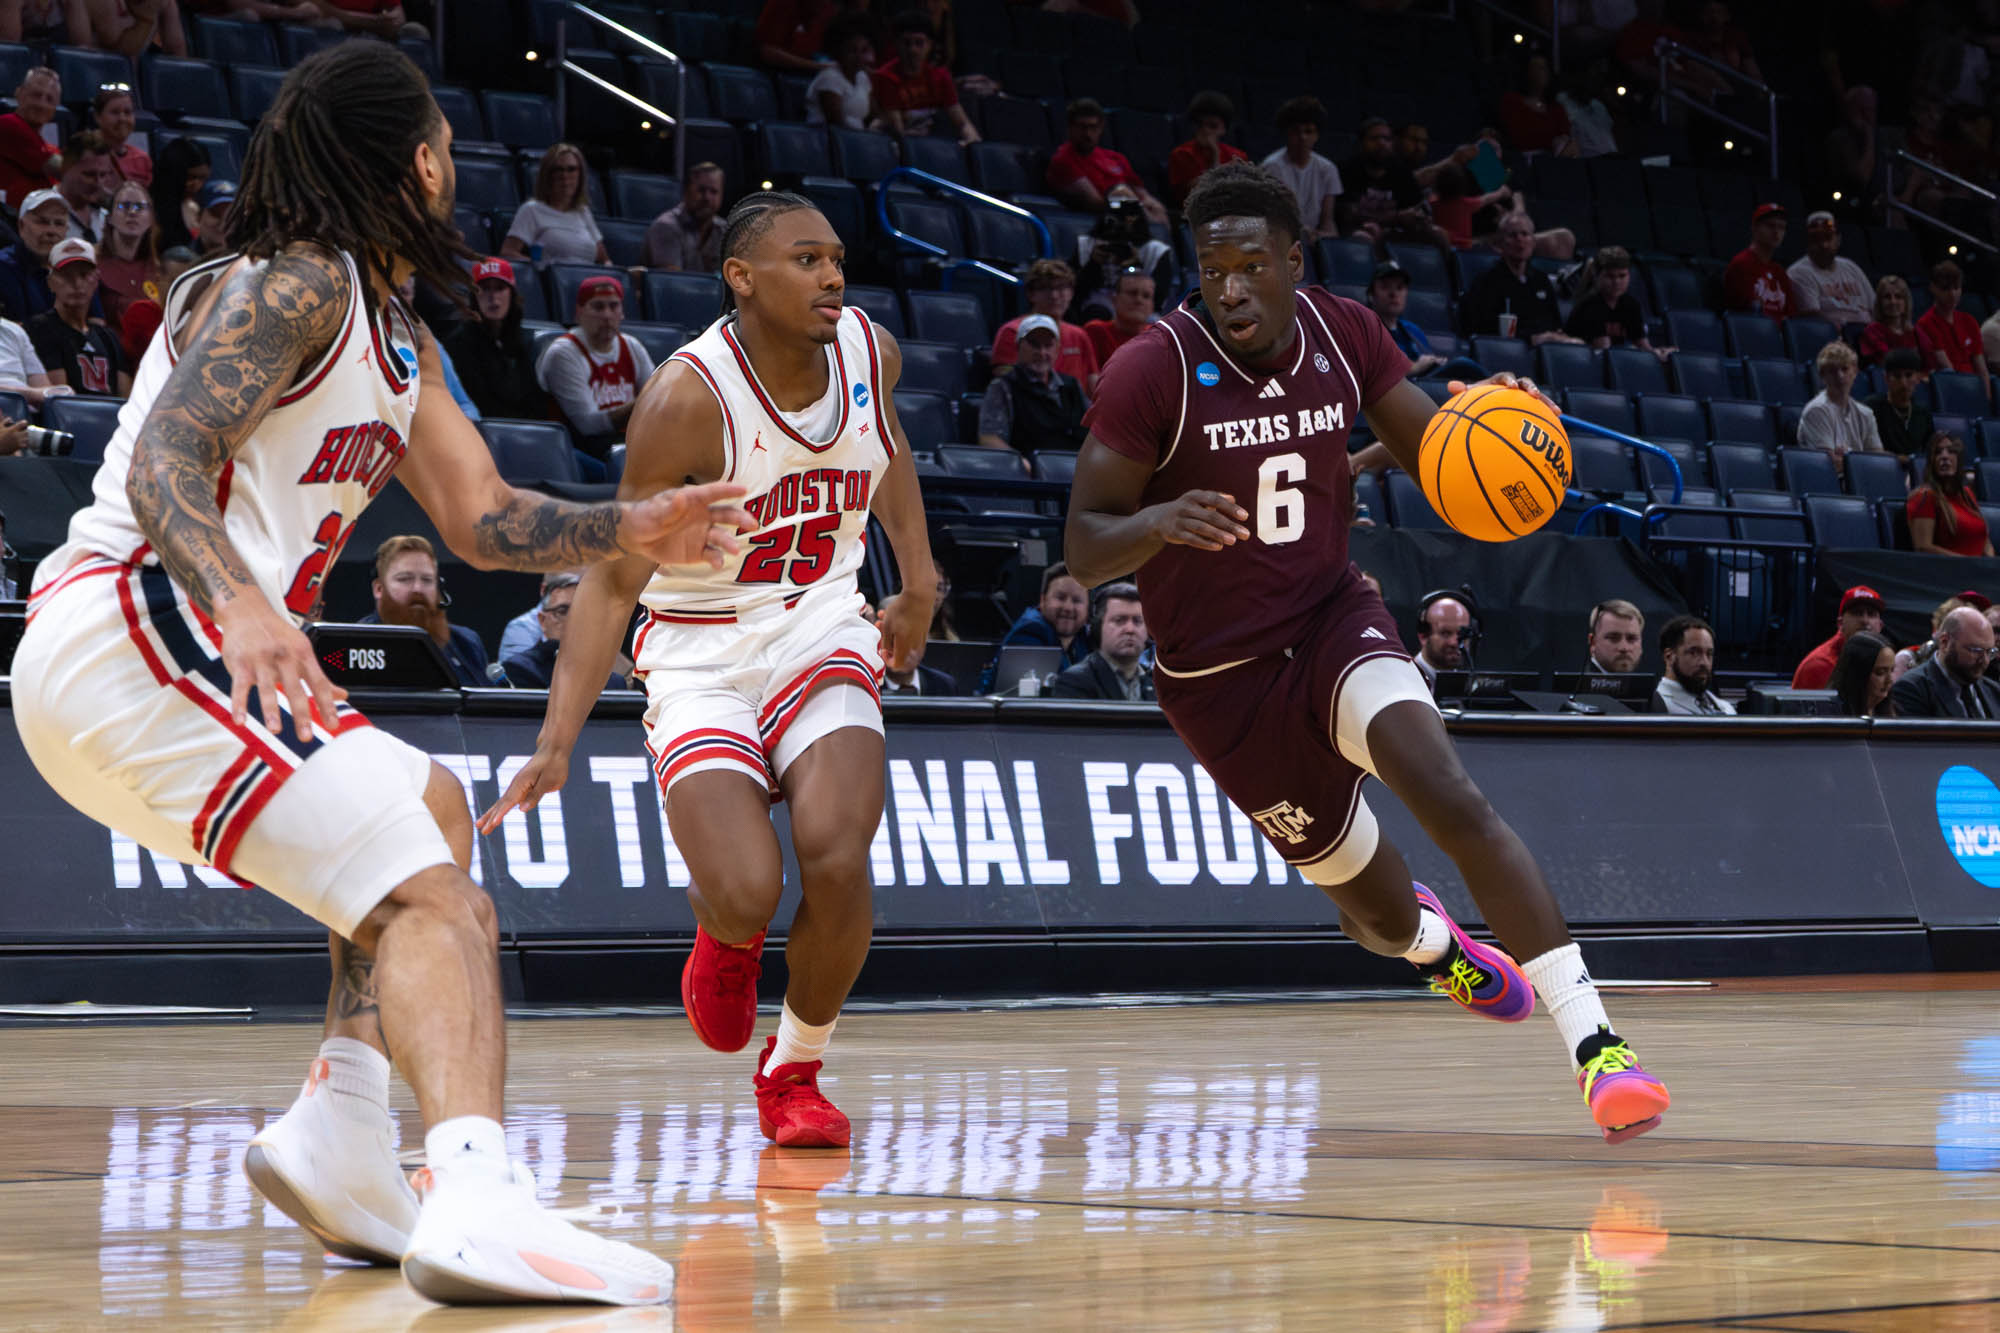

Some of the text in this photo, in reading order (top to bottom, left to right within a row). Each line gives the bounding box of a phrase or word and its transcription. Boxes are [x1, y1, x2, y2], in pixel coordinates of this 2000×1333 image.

[77, 354, 111, 393] N
[1203, 402, 1345, 451] TEXAS A&M
[736, 468, 872, 536] HOUSTON
[1257, 452, 1307, 545] 6
[735, 512, 842, 586] 25
[349, 648, 385, 670] POSS
